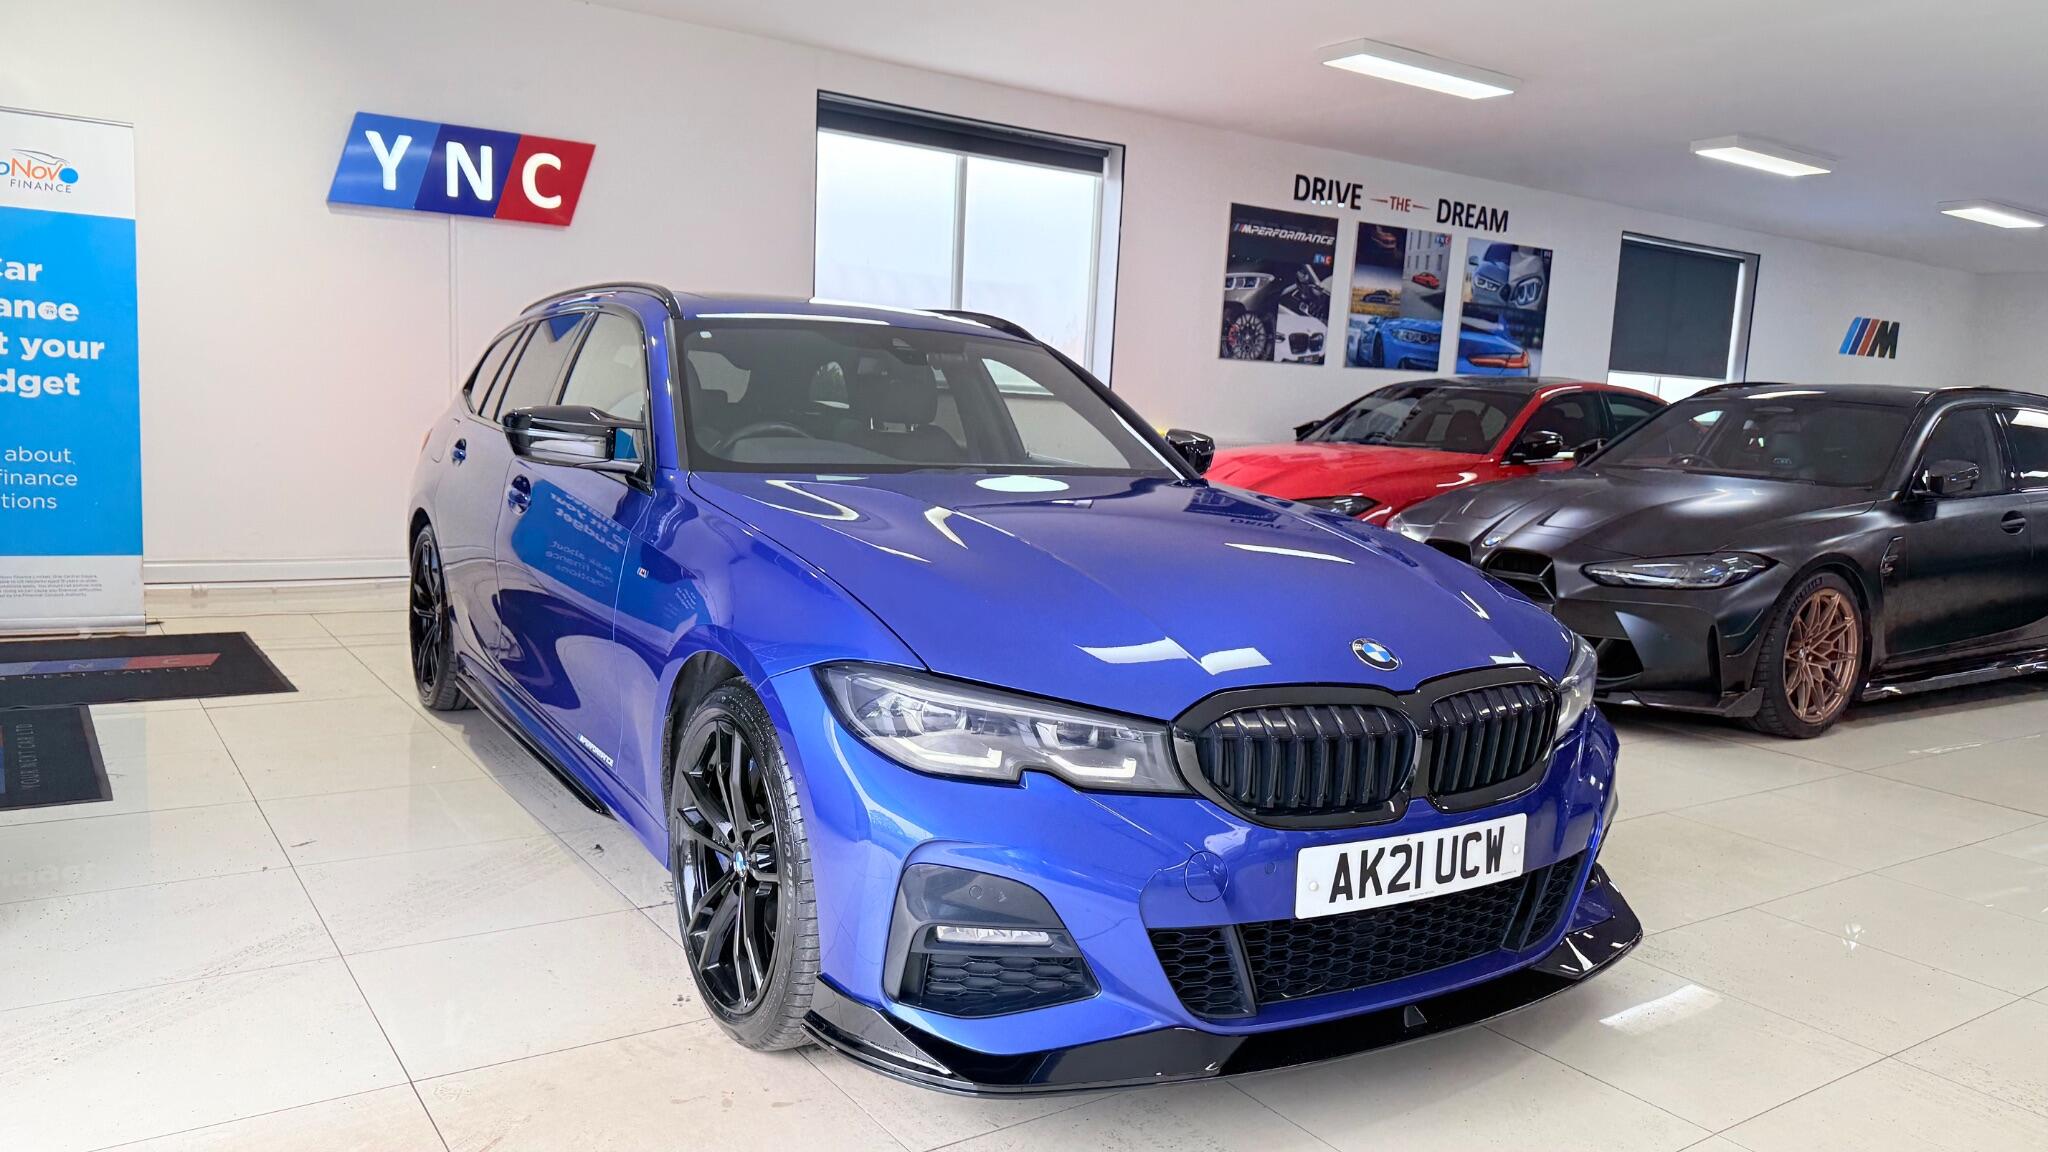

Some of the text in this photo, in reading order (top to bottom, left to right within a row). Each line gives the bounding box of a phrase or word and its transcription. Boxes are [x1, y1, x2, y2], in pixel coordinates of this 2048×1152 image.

[365, 130, 562, 209] YNC
[10, 178, 72, 194] FINANCE
[1293, 173, 1509, 234] DRIVE THE DREAM
[0, 257, 43, 282] ar
[19, 335, 105, 361] your
[0, 368, 80, 398] dget
[1, 493, 57, 510] tions
[1329, 826, 1505, 904] AK21 UCW
